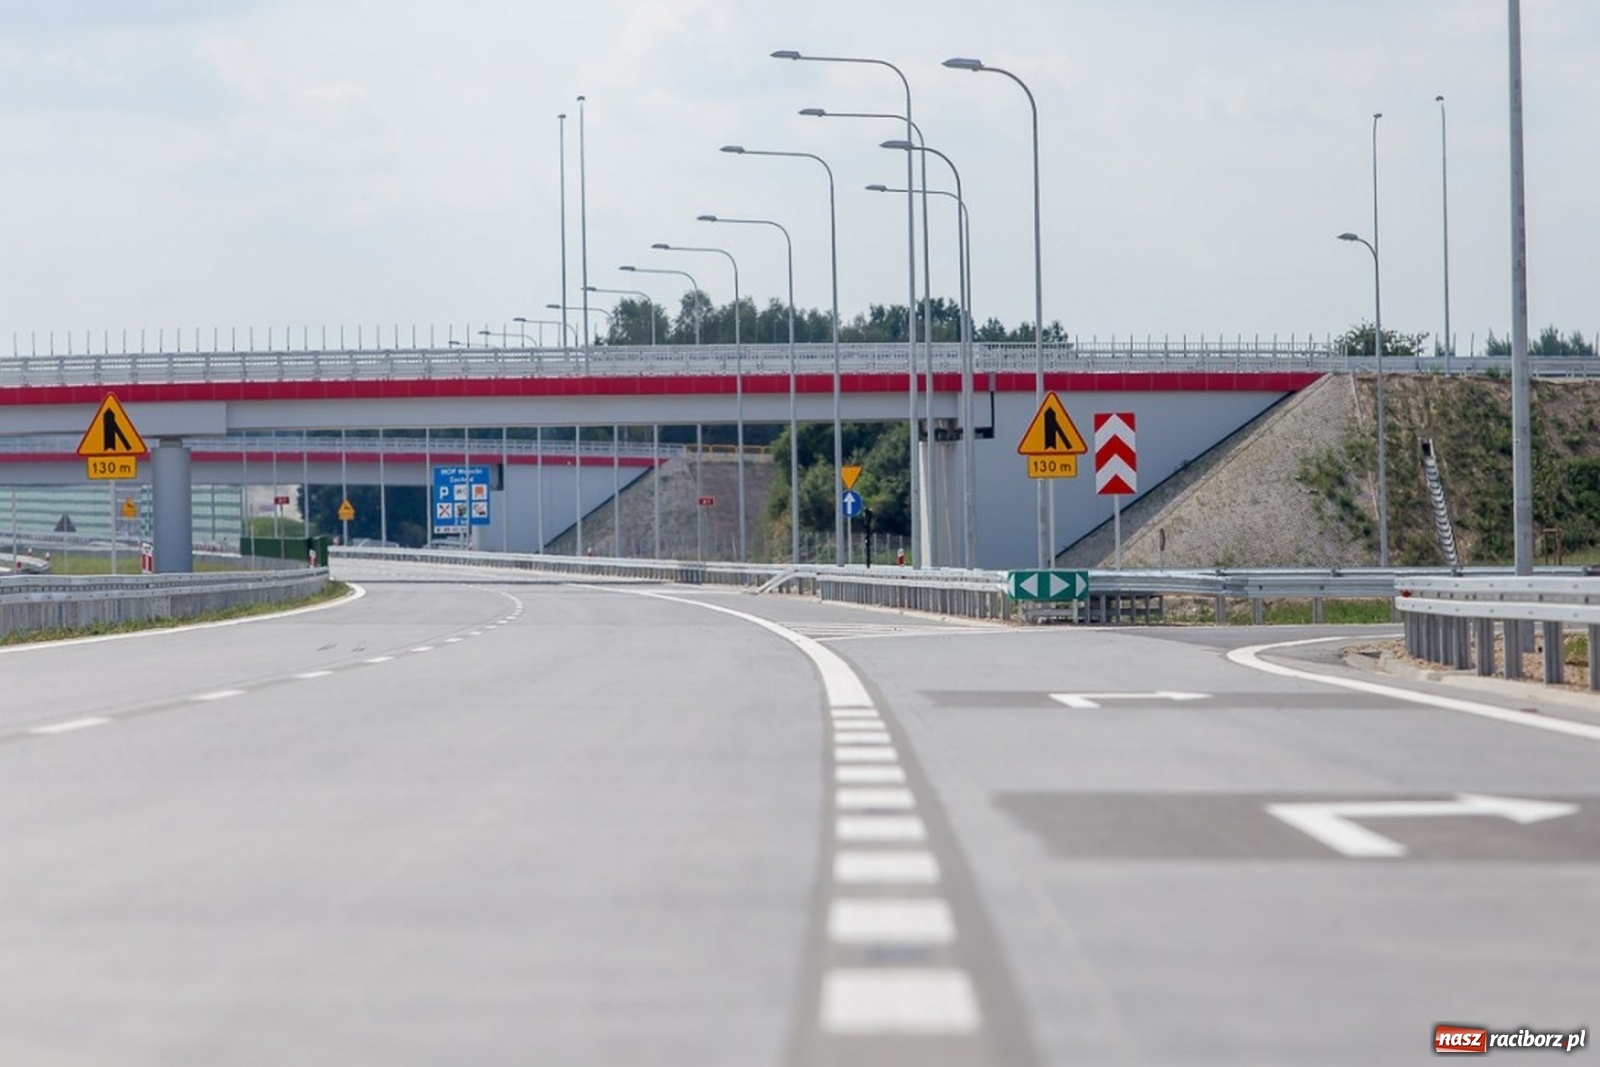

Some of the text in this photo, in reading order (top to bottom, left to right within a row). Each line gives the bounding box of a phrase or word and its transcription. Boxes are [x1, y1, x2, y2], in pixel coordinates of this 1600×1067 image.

[92, 461, 131, 474] 130 m
[1033, 460, 1071, 473] 130 m
[439, 486, 449, 500] P
